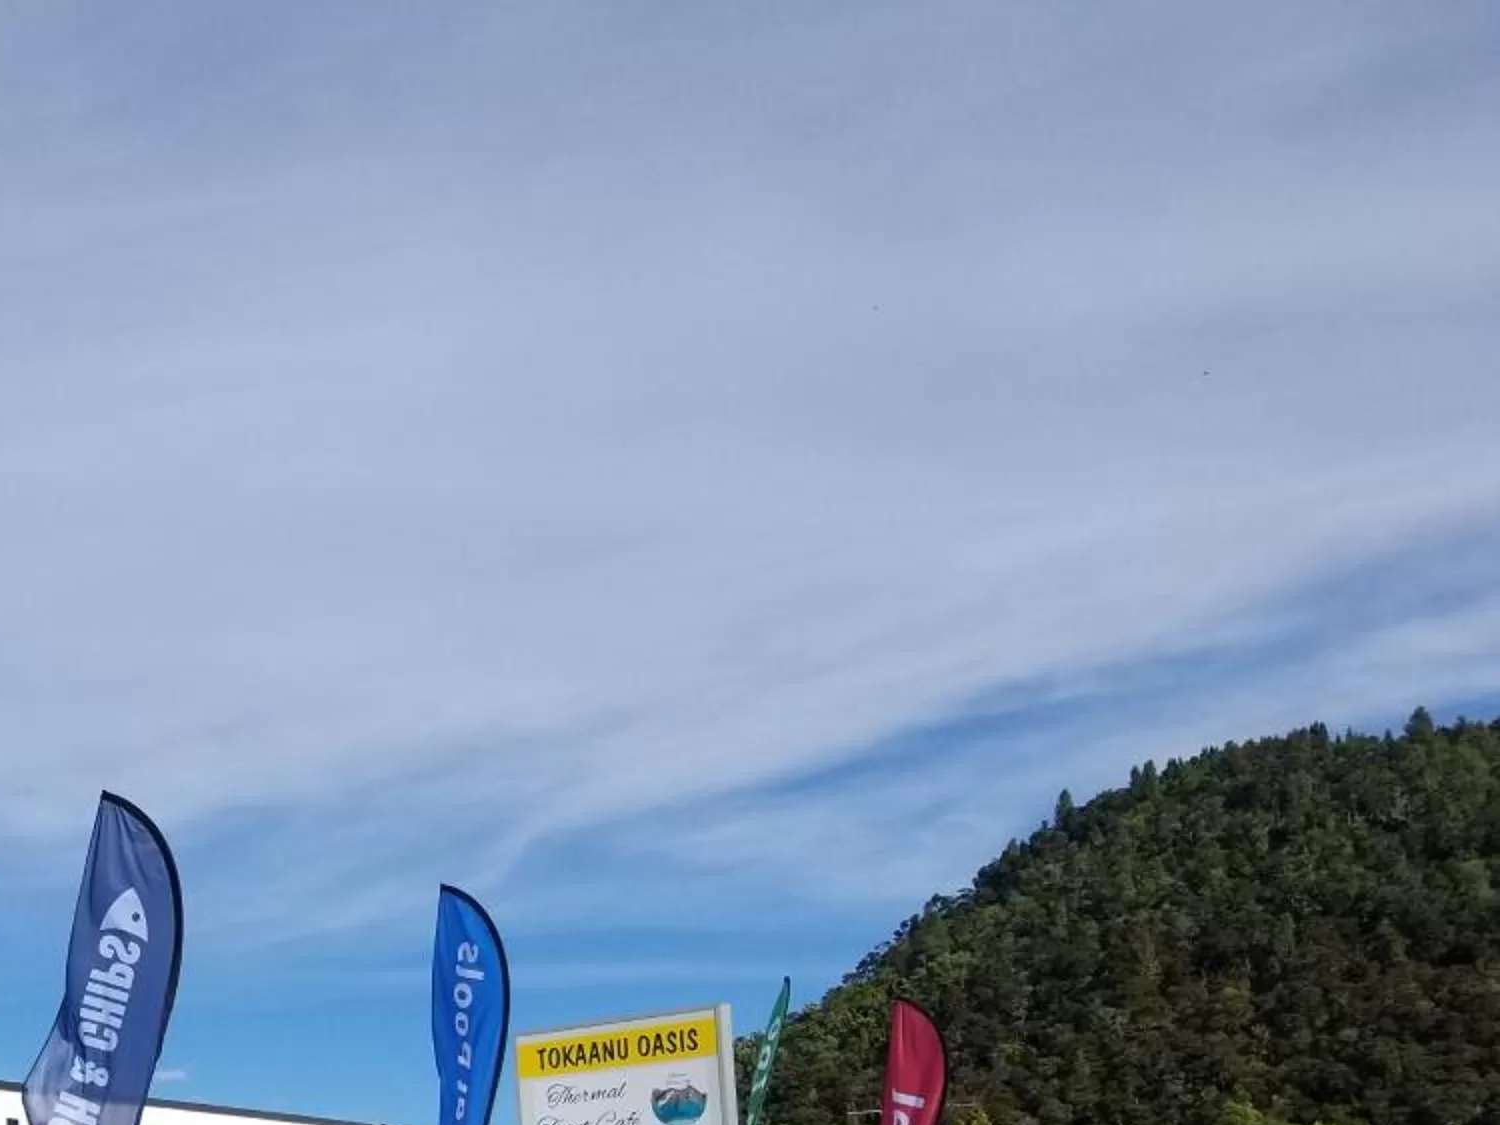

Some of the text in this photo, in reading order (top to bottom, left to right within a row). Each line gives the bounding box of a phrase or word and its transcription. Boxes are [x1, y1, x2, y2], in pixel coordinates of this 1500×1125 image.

[536, 1028, 700, 1071] TOKAANU OASIS
[547, 1080, 627, 1109] Thermal
